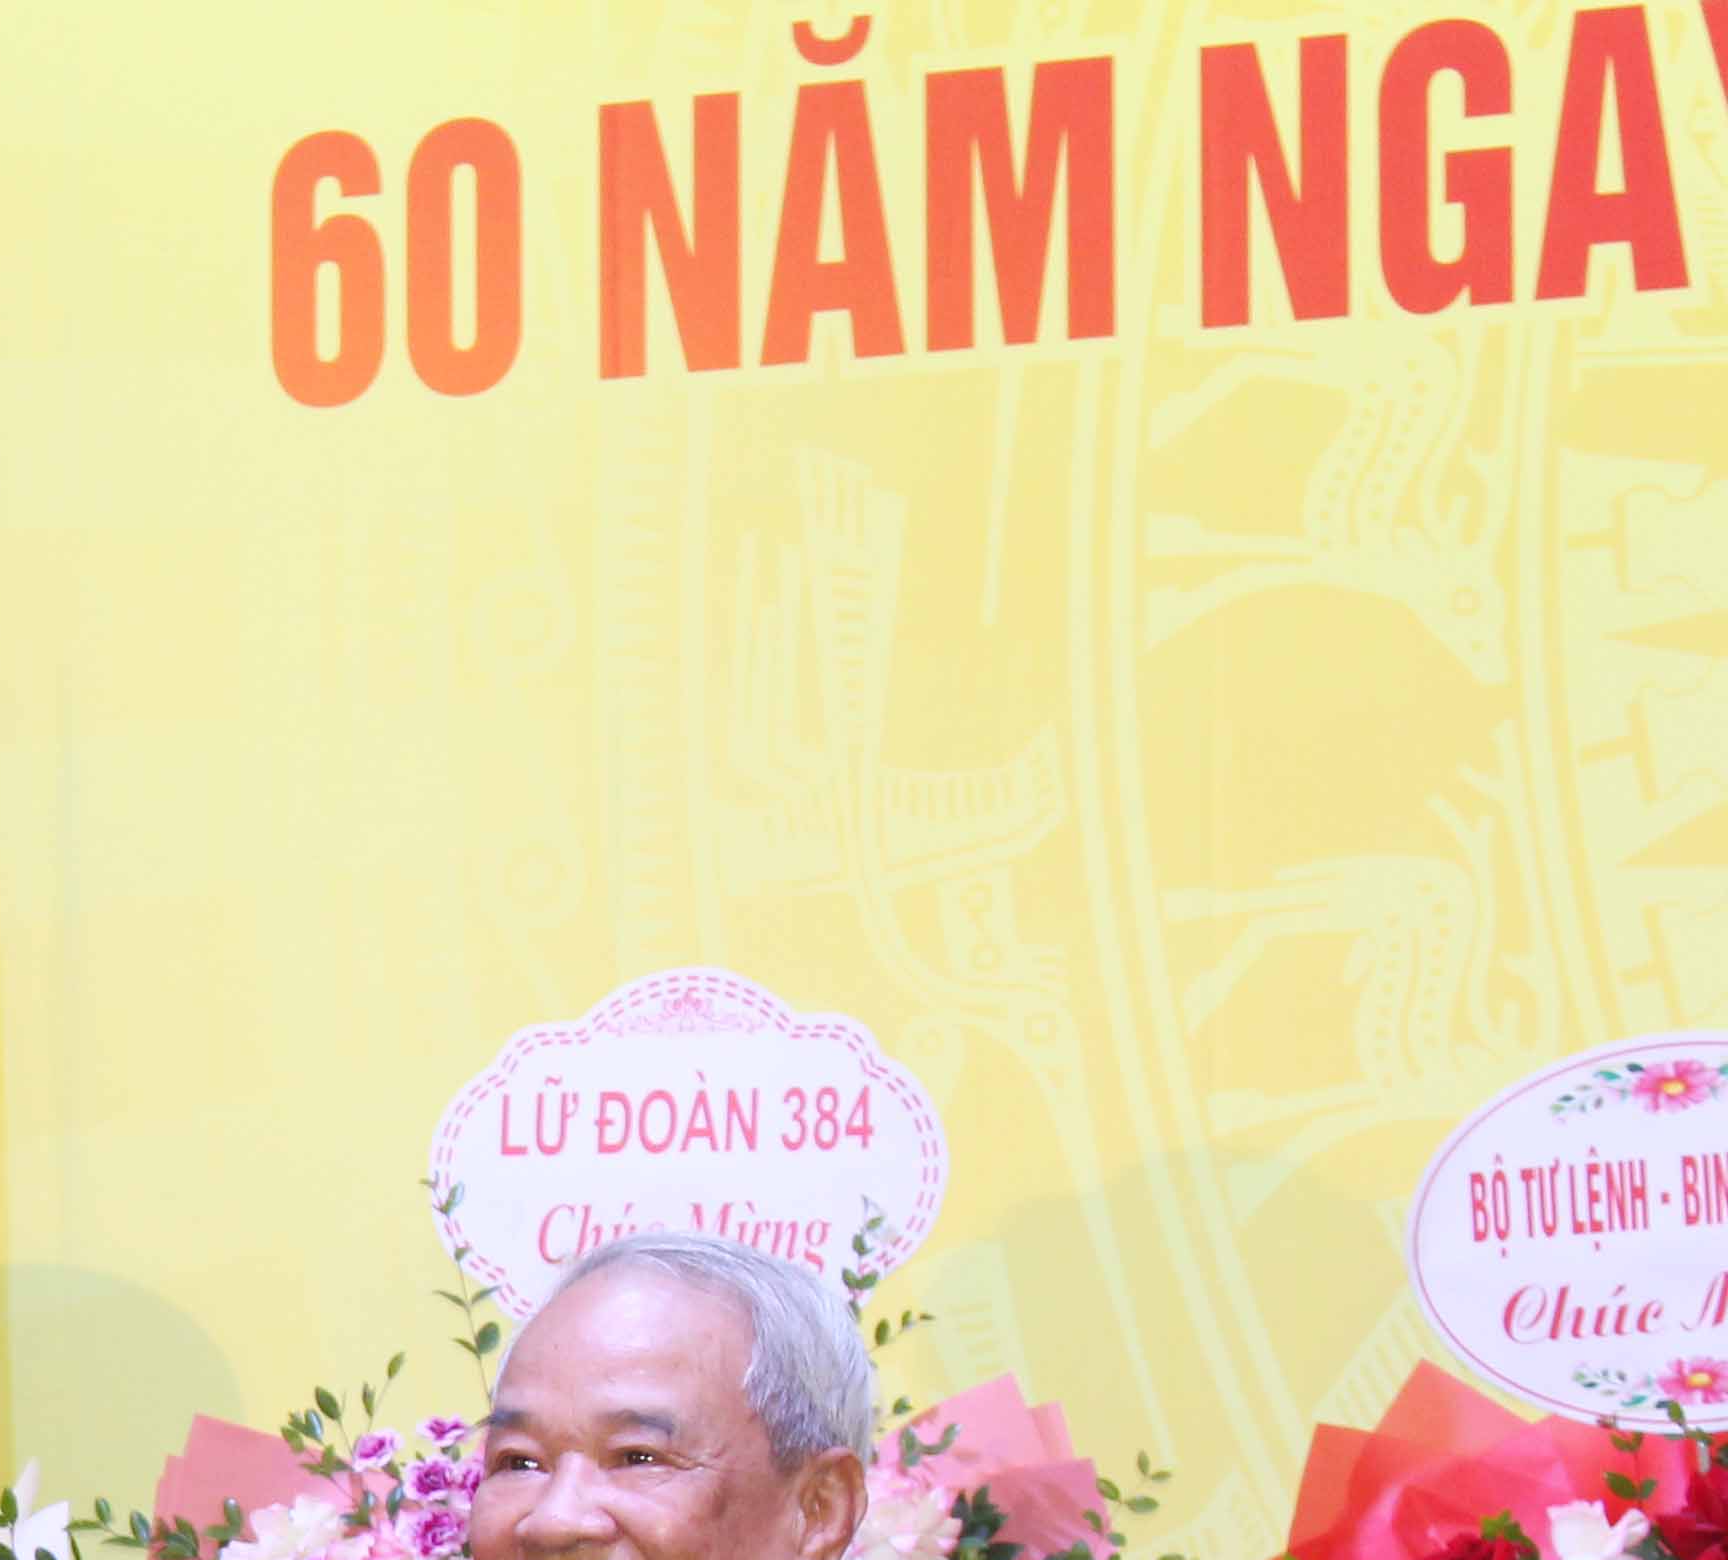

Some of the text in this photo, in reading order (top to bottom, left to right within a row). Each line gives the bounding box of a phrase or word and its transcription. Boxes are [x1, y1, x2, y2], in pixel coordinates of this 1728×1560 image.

[272, 116, 522, 408] 60
[597, 14, 1117, 382] NĂM
[500, 1070, 875, 1156] LỮ ĐOÀN 384
[1469, 1153, 1513, 1258] BỘ
[1520, 1155, 1561, 1238] TƯ
[1569, 1145, 1650, 1252] LỆNH
[1502, 1283, 1665, 1345] Chúc
